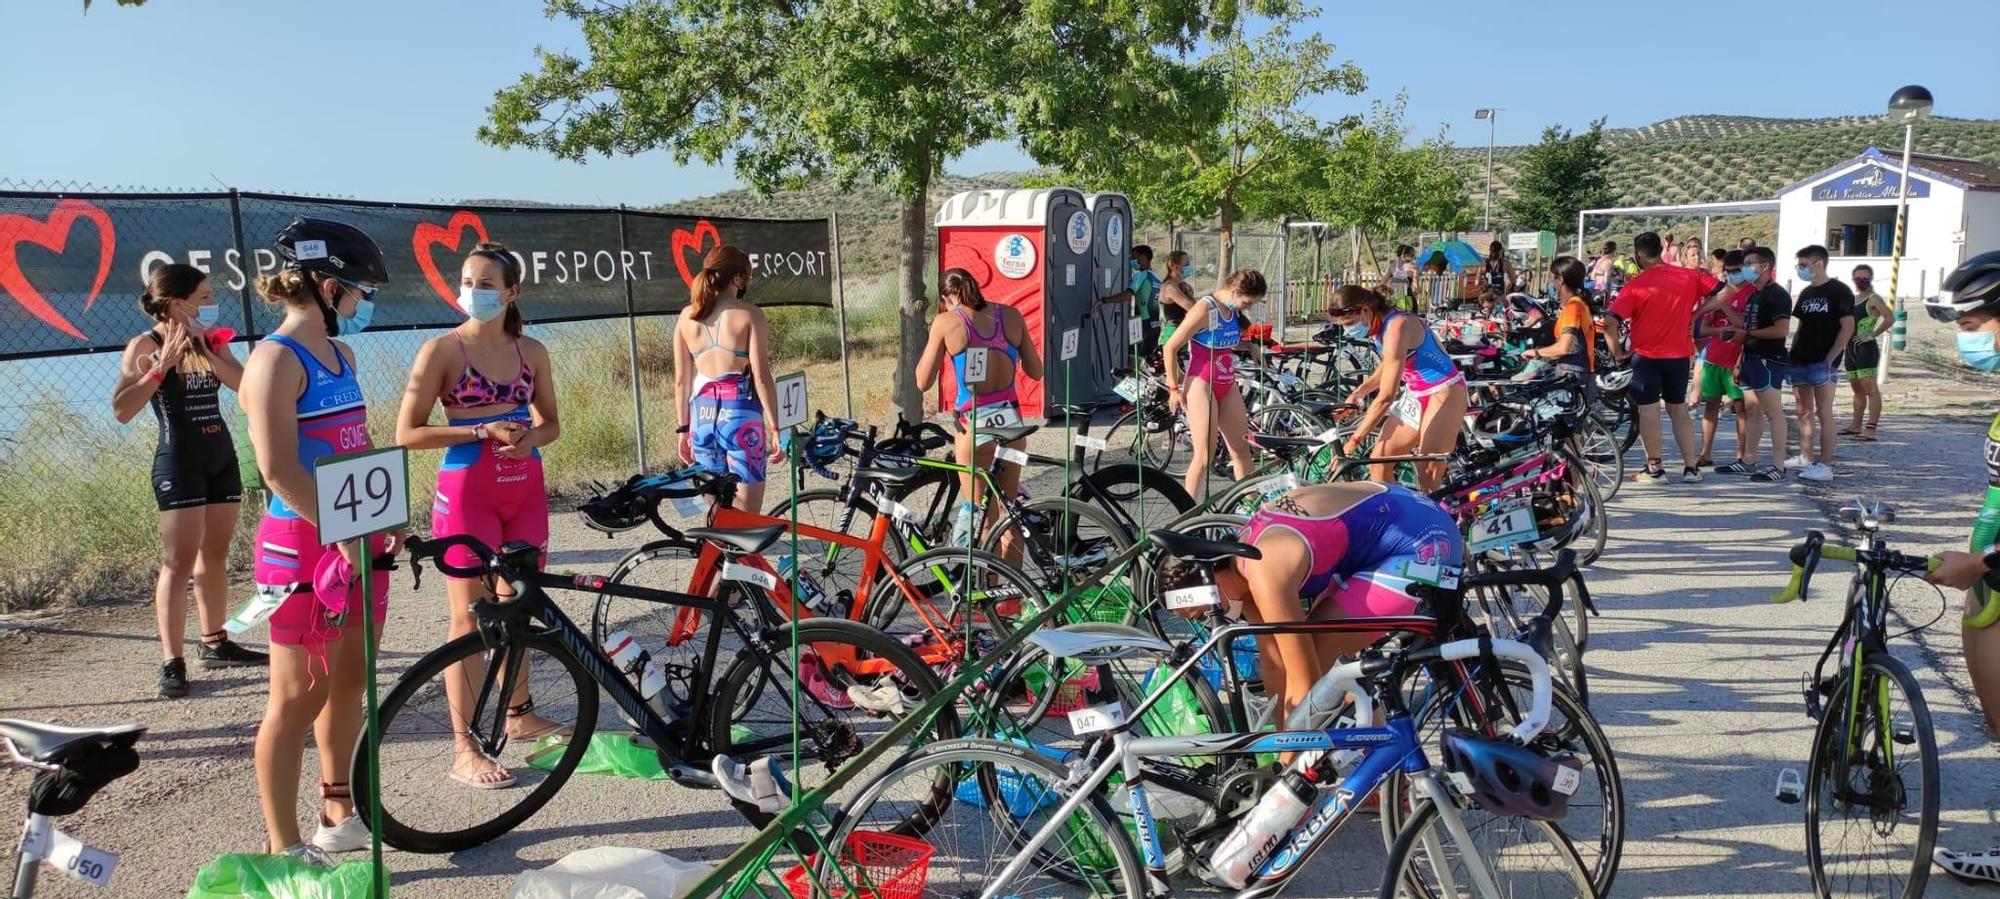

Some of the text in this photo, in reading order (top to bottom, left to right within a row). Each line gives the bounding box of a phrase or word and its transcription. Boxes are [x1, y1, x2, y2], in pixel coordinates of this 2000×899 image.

[748, 250, 826, 278] FSPORT
[1003, 257, 1026, 268] fersa
[1064, 332, 1077, 354] 43
[969, 351, 984, 376] 45
[782, 382, 800, 418] 47
[1404, 403, 1417, 418] 35
[985, 413, 1005, 429] 40
[334, 466, 392, 523] 49
[1486, 514, 1513, 535] 41
[1175, 593, 1195, 605] 045
[1077, 715, 1096, 730] 047
[1275, 735, 1324, 744] SPORT
[1131, 790, 1157, 865] ORBEA
[1270, 788, 1355, 875] ORBEA
[67, 854, 104, 880] 050
